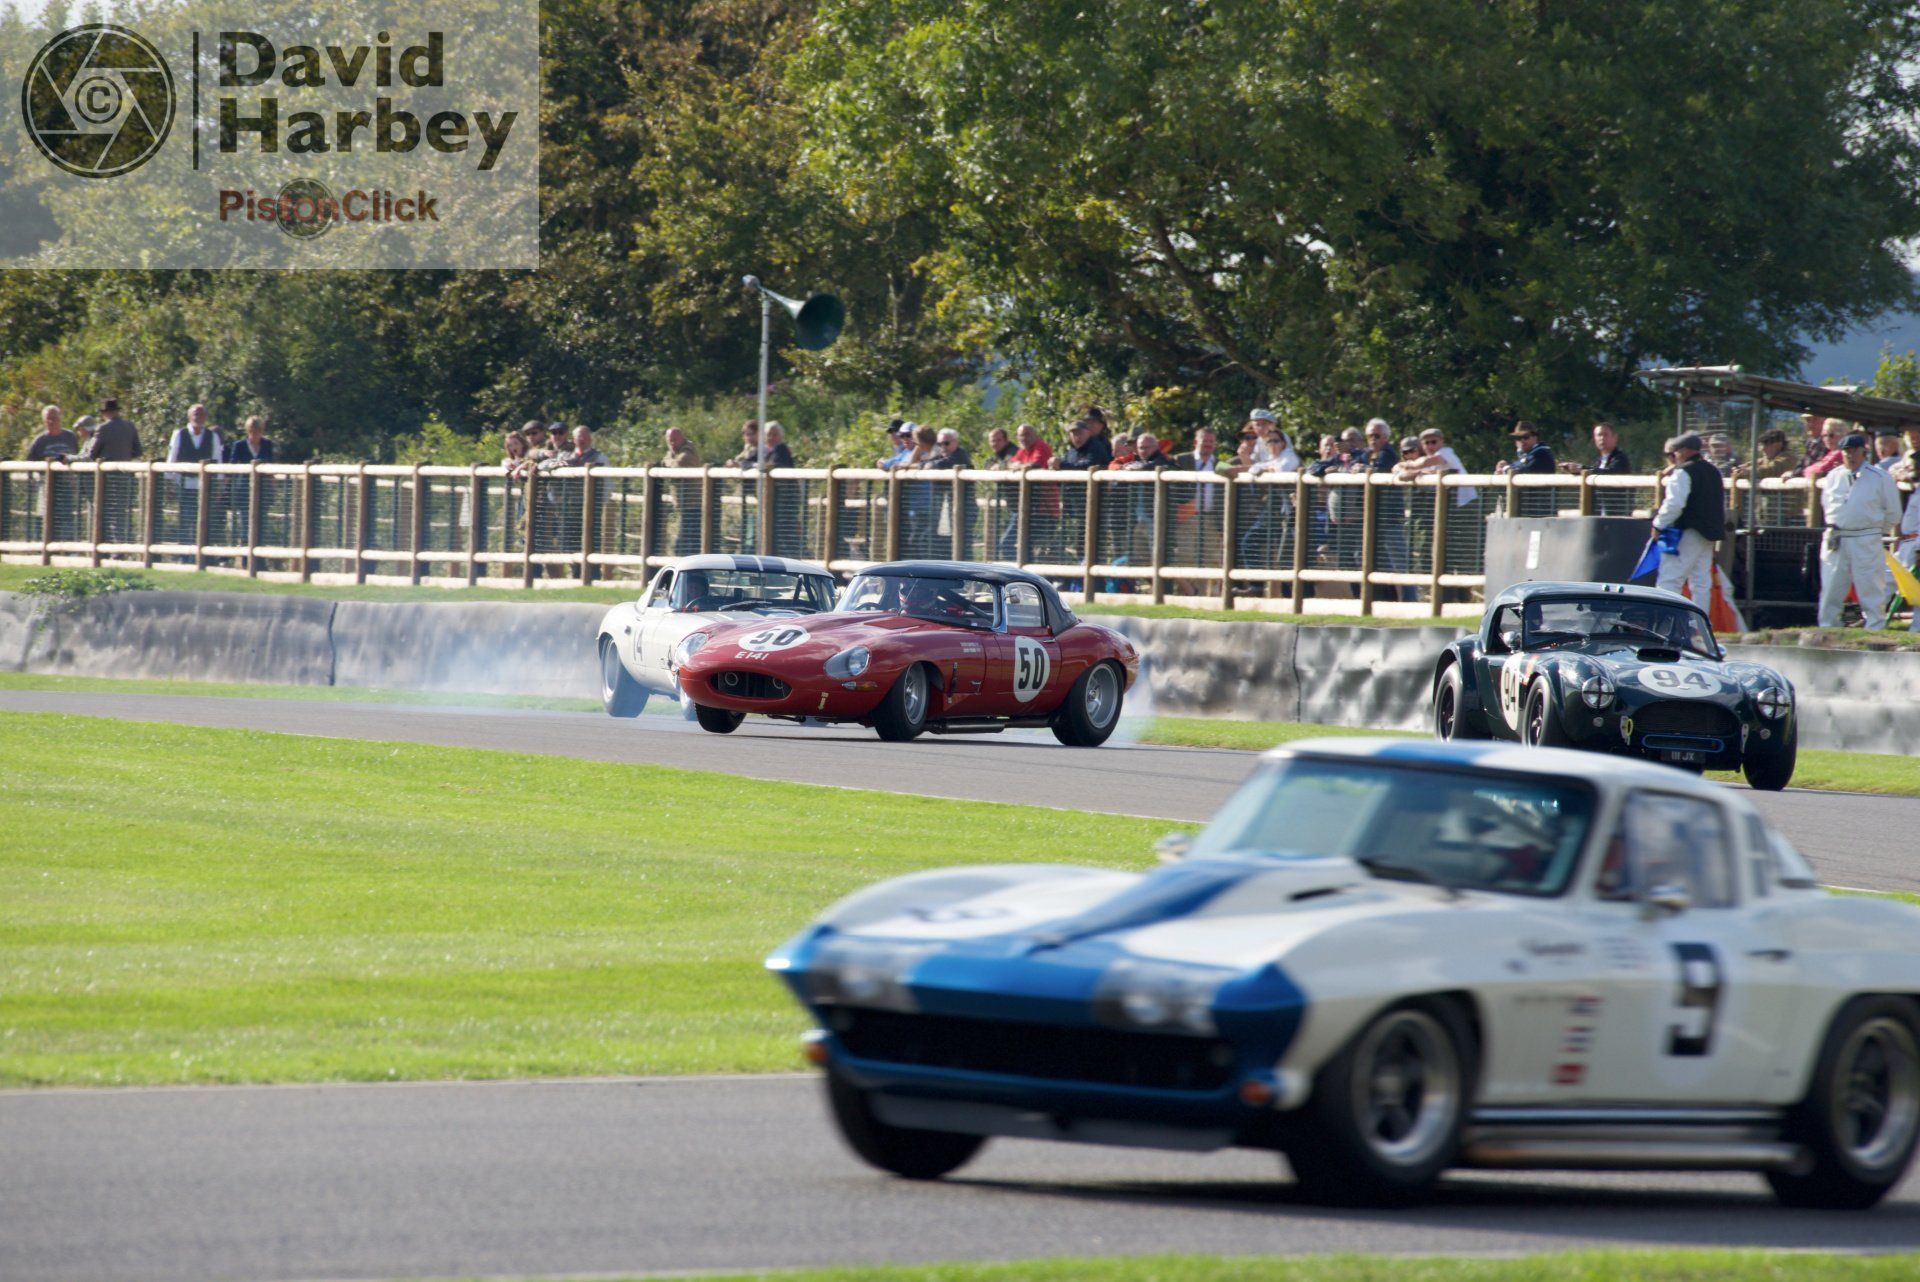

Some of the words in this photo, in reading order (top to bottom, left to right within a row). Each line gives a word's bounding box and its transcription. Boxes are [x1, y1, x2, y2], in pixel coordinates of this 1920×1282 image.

[749, 628, 804, 646] 50
[1018, 646, 1045, 690] 50
[1651, 669, 1711, 690] 94
[1504, 667, 1517, 712] 94
